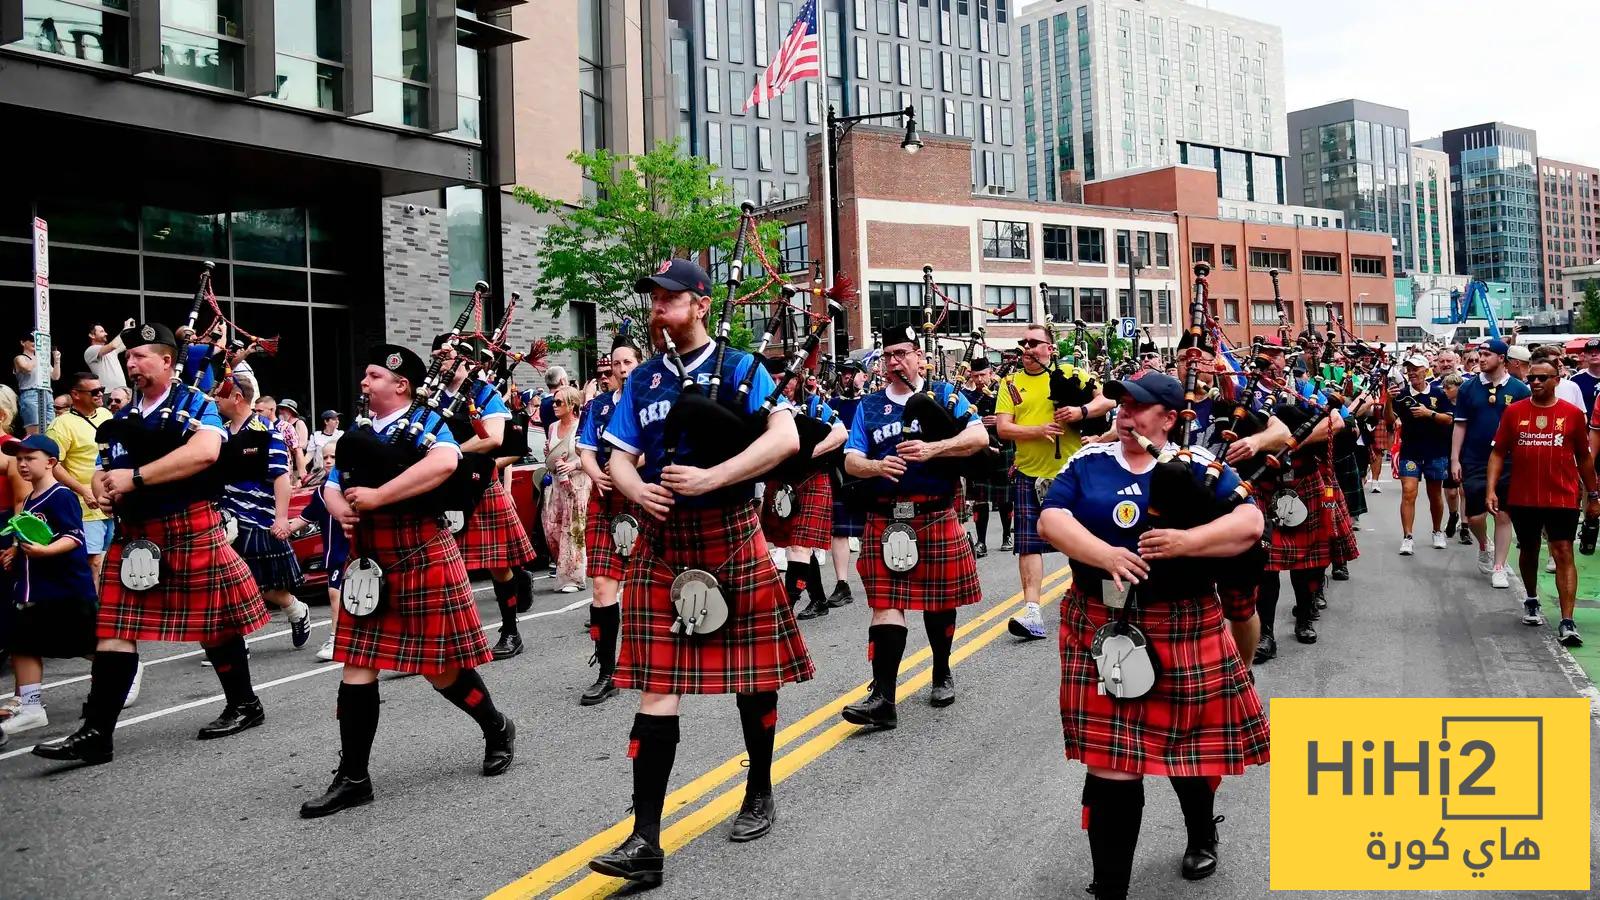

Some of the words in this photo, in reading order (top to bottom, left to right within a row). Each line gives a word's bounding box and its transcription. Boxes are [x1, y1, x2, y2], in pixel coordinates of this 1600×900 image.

[1125, 322, 1133, 335] P
[649, 372, 662, 389] B
[638, 399, 671, 430] RED
[883, 403, 893, 415] B
[872, 420, 902, 444] RED
[331, 569, 339, 581] 8
